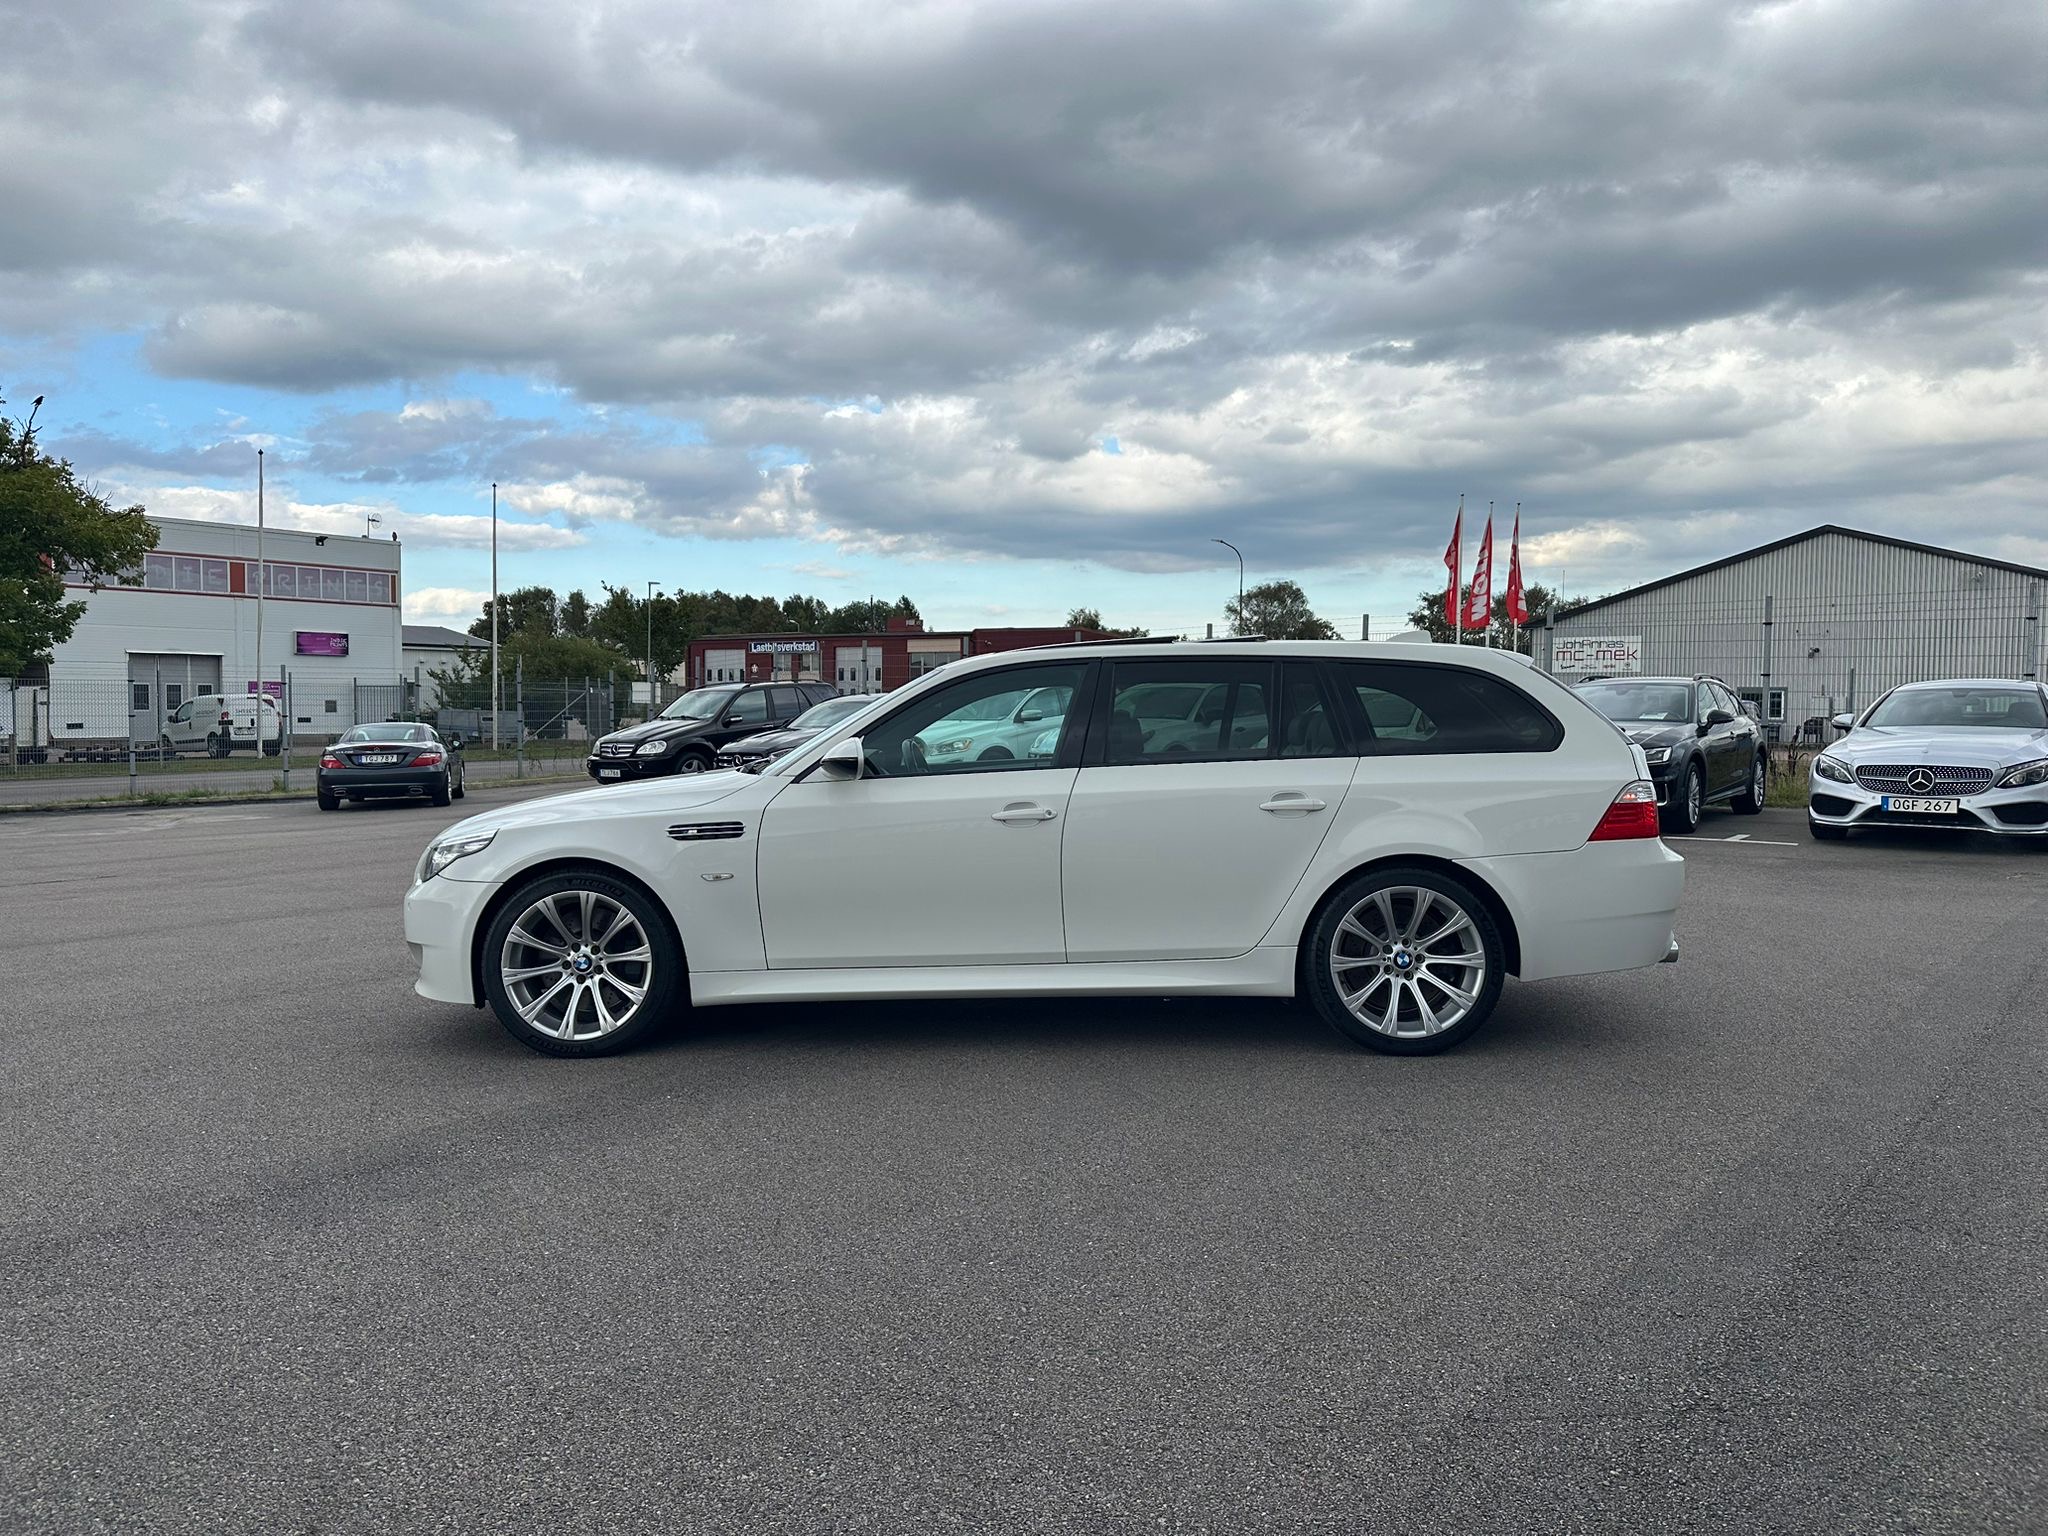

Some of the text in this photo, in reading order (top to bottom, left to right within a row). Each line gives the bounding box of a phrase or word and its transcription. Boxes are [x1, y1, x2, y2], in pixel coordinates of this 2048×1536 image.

[252, 571, 384, 596] PRINTS
[1556, 646, 1637, 661] mc-mek
[1893, 799, 1951, 811] OGF 267
